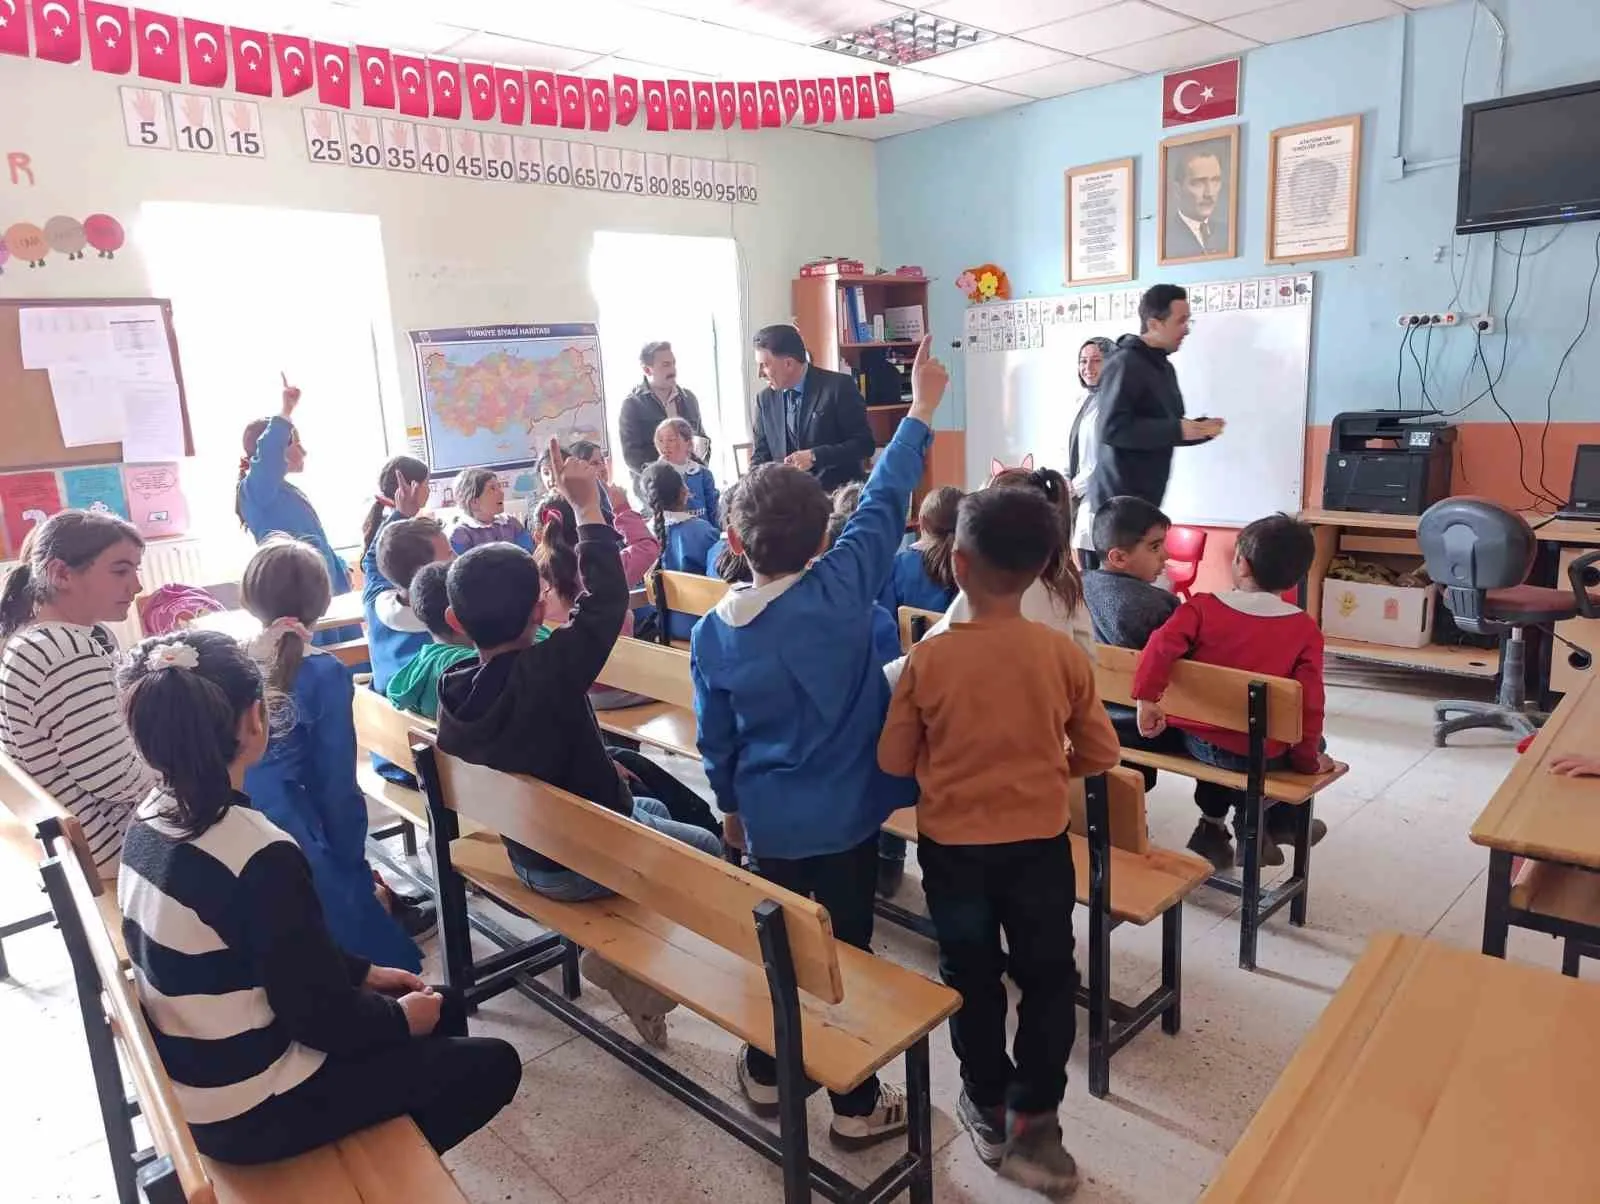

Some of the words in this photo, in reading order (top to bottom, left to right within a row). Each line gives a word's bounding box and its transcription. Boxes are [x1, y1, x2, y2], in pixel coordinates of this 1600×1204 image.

[140, 121, 158, 144] 5
[181, 125, 214, 150] 10
[230, 131, 260, 154] 15
[311, 139, 342, 161] 25
[350, 143, 381, 166] 30
[388, 147, 416, 169] 35
[7, 152, 34, 185] R
[421, 152, 450, 173] 40
[455, 155, 482, 176] 45
[487, 159, 513, 179] 50
[518, 161, 541, 182] 55
[546, 165, 570, 184] 60
[575, 167, 596, 187] 65
[600, 170, 621, 190] 70
[624, 173, 644, 193] 75
[649, 176, 668, 194] 80
[672, 178, 691, 197] 85
[693, 181, 713, 199] 90
[715, 183, 736, 202] 95
[738, 184, 757, 201] 100
